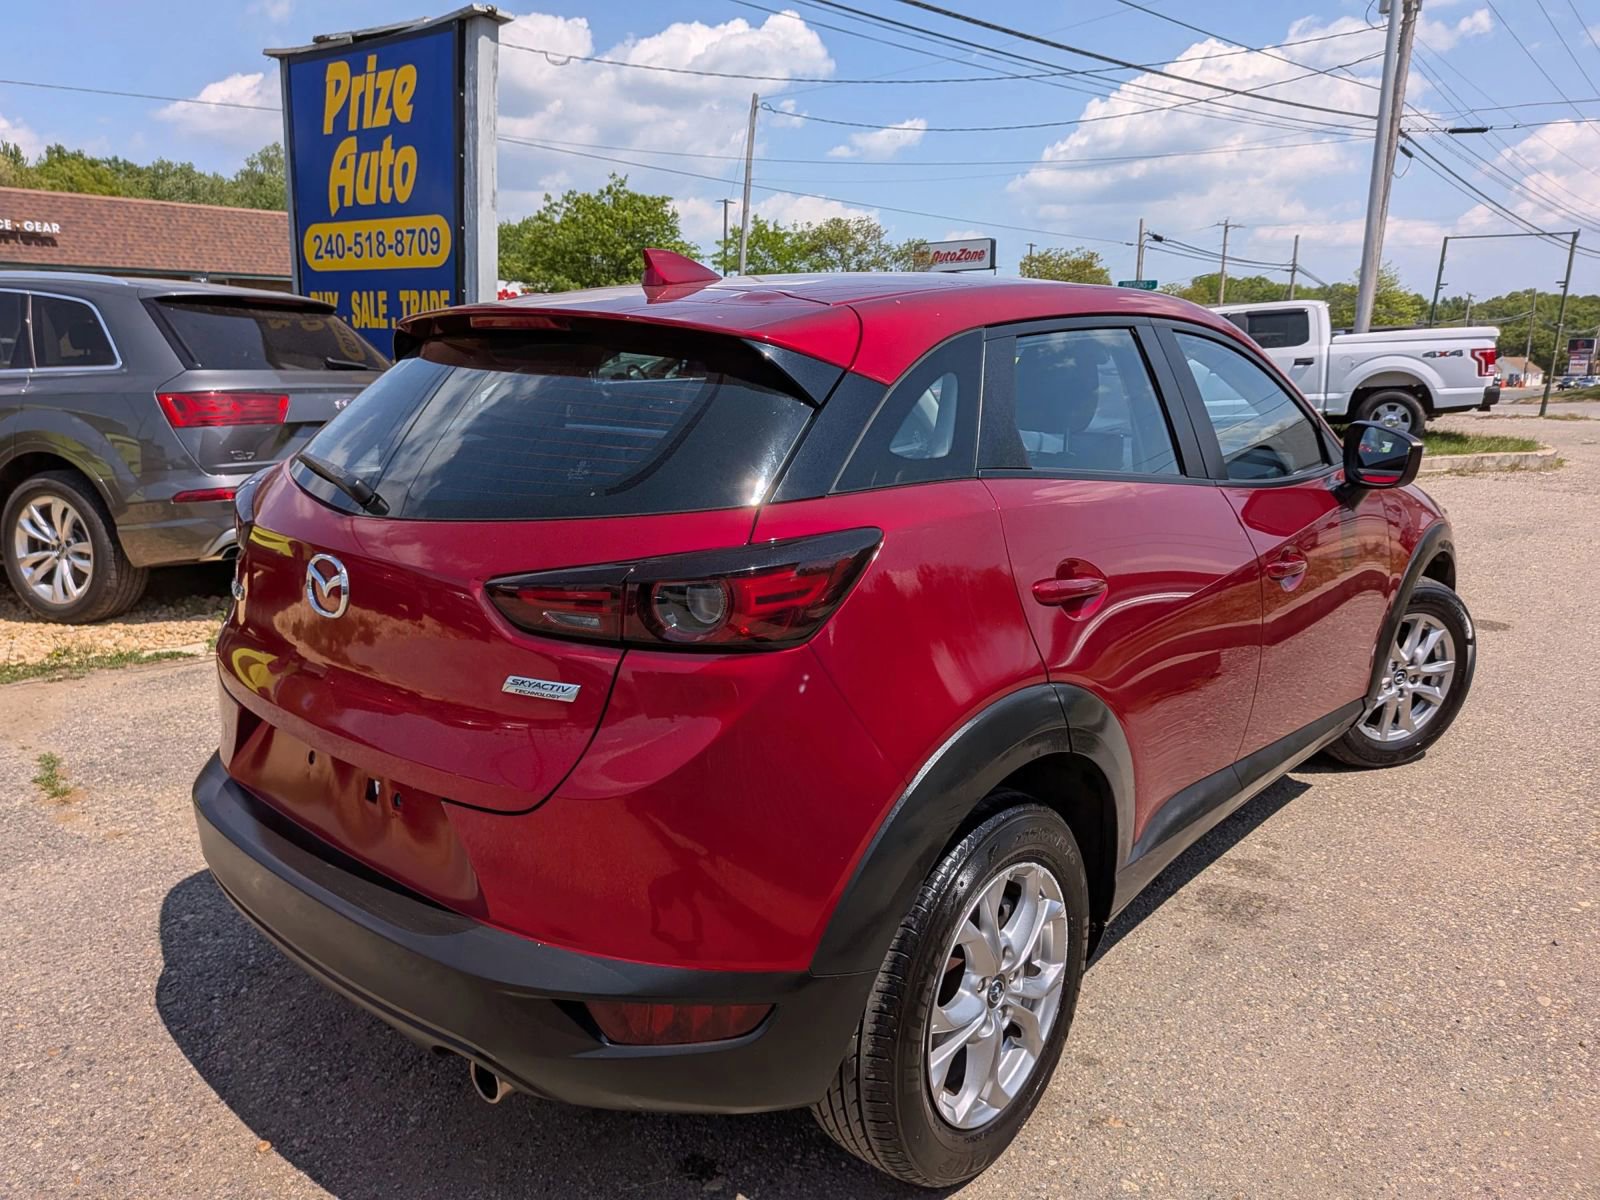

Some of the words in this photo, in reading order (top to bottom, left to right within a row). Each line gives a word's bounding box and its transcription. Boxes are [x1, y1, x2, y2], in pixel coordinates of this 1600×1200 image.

[323, 54, 417, 135] Prize
[328, 134, 417, 216] Auto
[24, 220, 60, 234] GEAR
[313, 227, 441, 260] 240-518-8709
[932, 248, 986, 263] AutoZone
[352, 291, 388, 329] SALE
[510, 678, 572, 693] SKYACTIV
[514, 688, 562, 699] TECHNOLOGY
